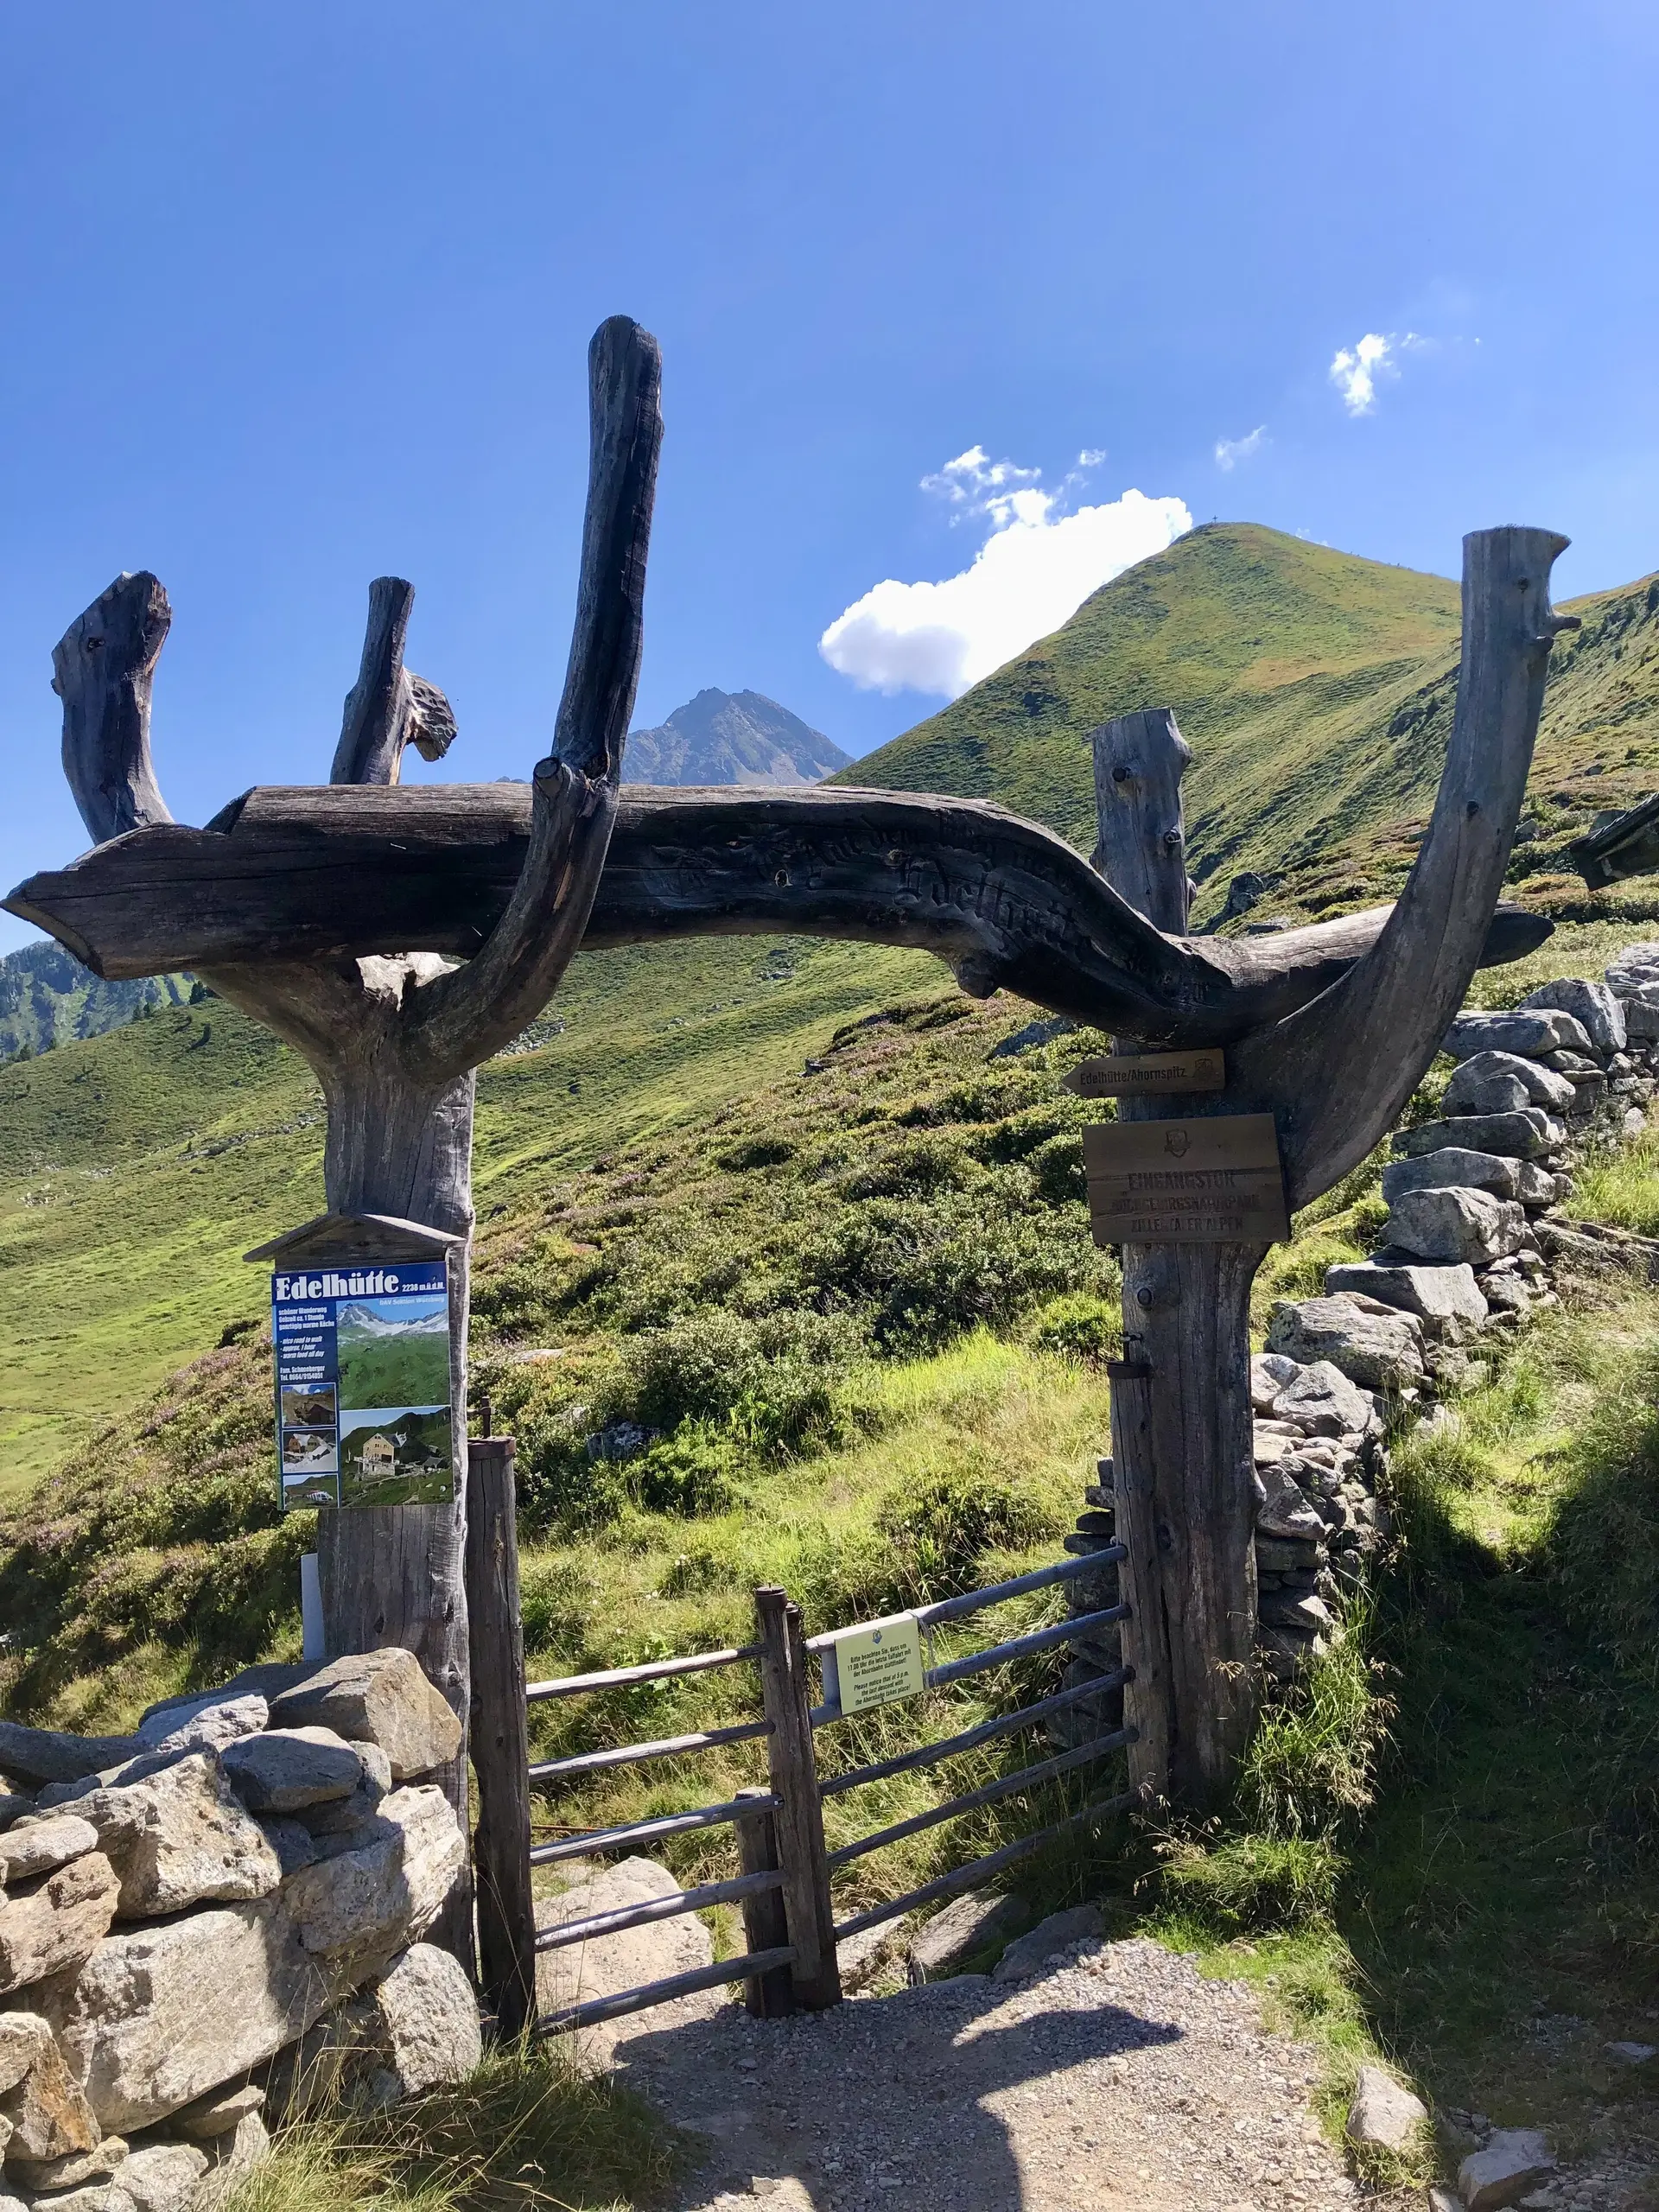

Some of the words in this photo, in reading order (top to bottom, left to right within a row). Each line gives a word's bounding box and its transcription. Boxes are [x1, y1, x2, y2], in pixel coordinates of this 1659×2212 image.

[1080, 1065, 1187, 1085] Edelhütte/Ahornspitz
[276, 1270, 399, 1300] Edelhütte
[402, 1283, 418, 1292] 2238
[861, 1650, 880, 1660] beachten
[861, 1664, 883, 1675] Ahornbahn
